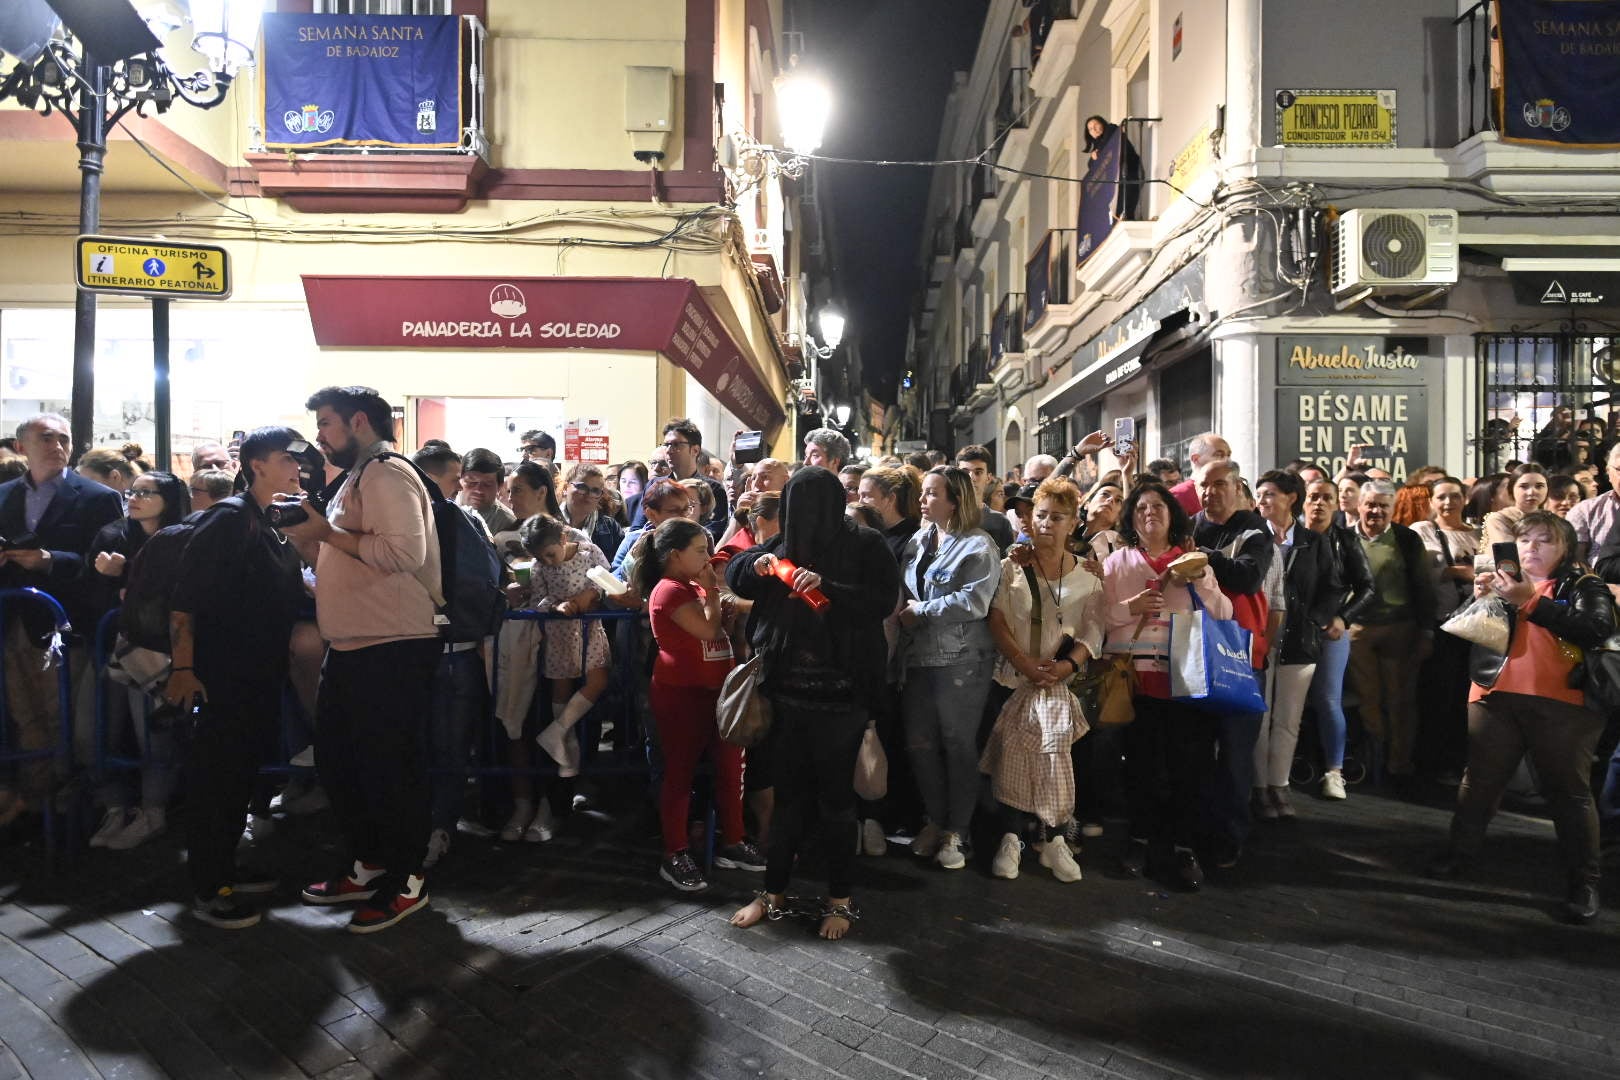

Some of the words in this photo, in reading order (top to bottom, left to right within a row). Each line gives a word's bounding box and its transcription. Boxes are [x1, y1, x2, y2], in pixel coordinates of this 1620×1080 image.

[299, 24, 368, 42] SEMANA
[371, 25, 424, 41] SANTA
[1533, 20, 1601, 36] SEMANA
[326, 45, 342, 57] DE
[1560, 42, 1575, 55] DE
[1294, 103, 1340, 130] FRANCISCO
[1343, 103, 1378, 130] PIZARRO
[1286, 131, 1346, 141] CONQUISTADOR
[98, 244, 149, 256] OFICINA
[153, 248, 208, 260] TURISMO
[87, 275, 155, 287] ITINERARIO
[159, 279, 219, 290] PEATONAL
[402, 320, 502, 338] PANADERIA
[510, 321, 532, 338] LA
[540, 321, 621, 339] SOLEDAD
[1290, 344, 1362, 369] Abuela
[1363, 343, 1419, 370] Justa
[1299, 389, 1408, 422] BÉSAME
[1299, 426, 1333, 453] EN
[1343, 426, 1408, 453] ESTA
